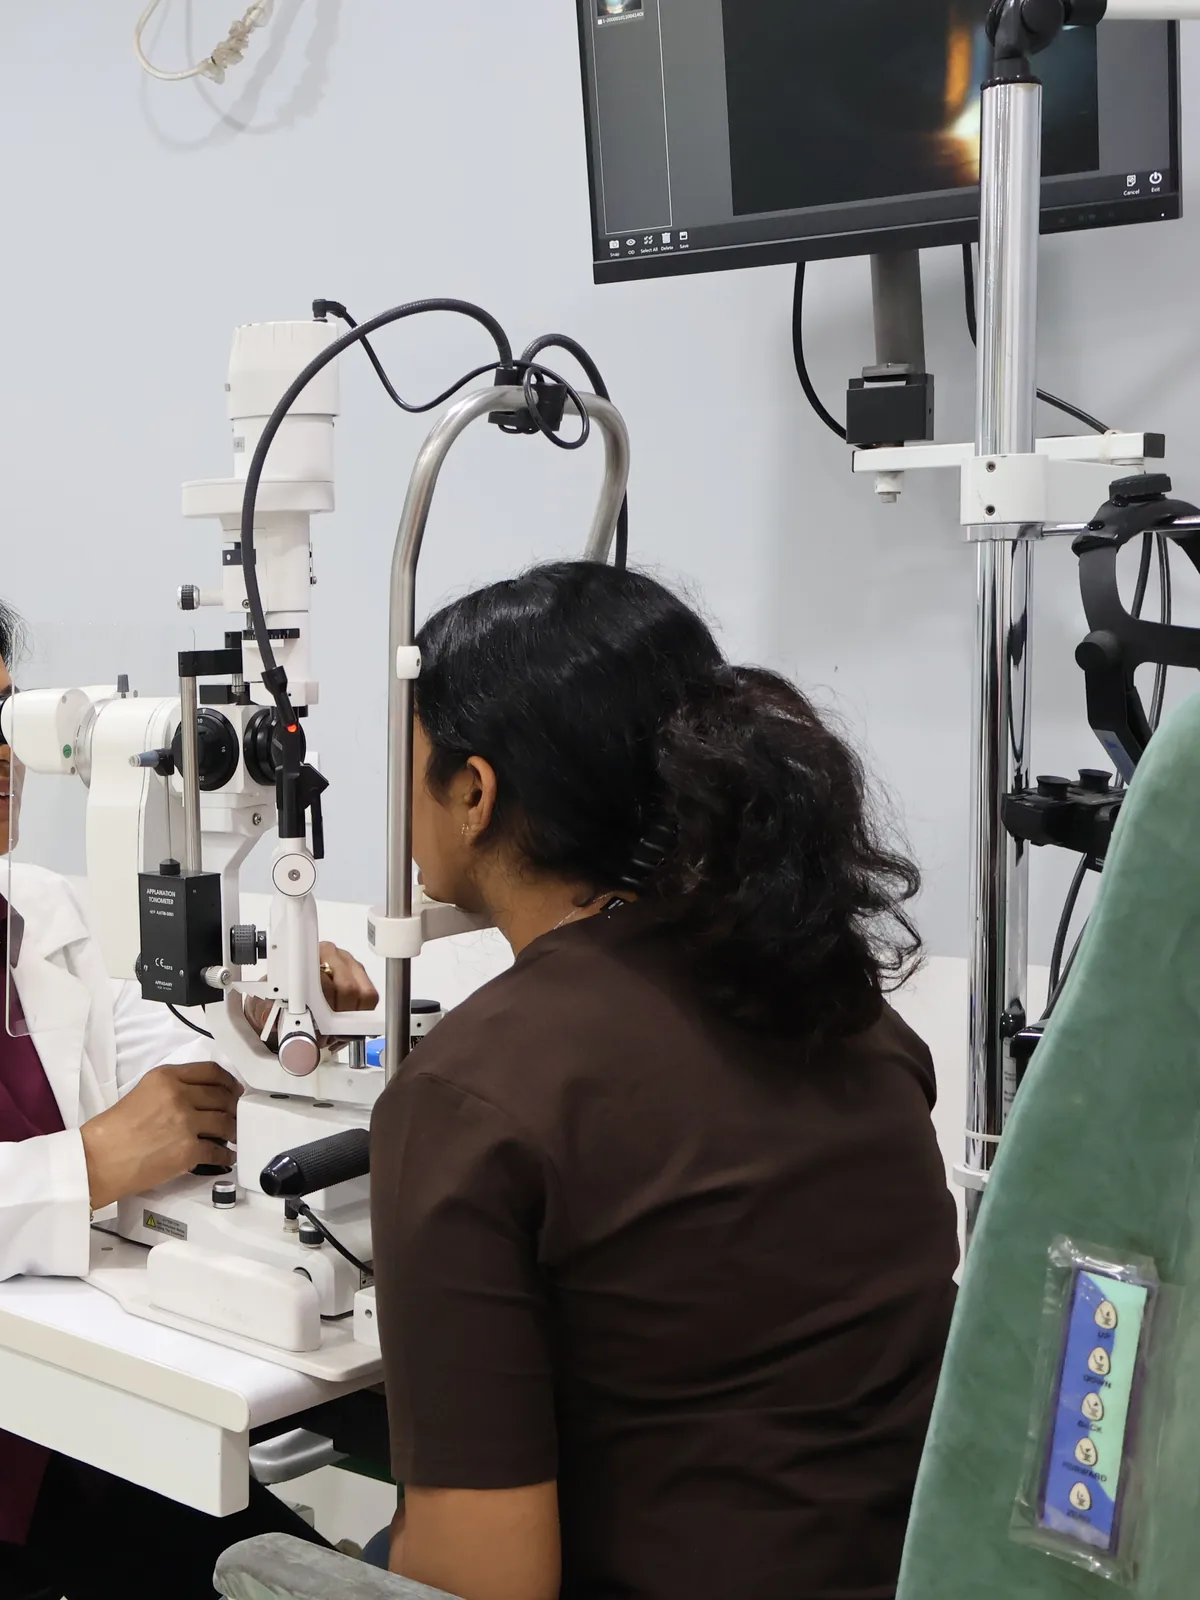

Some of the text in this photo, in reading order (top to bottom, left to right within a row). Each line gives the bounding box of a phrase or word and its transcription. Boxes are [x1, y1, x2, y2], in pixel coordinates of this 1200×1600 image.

[1123, 188, 1140, 196] Cancel
[146, 888, 176, 898] APPLANATION
[148, 896, 174, 905] TONOMETER
[1097, 1331, 1112, 1340] UP
[1083, 1374, 1112, 1390] DOWN
[1077, 1419, 1103, 1434] BACK
[1062, 1461, 1108, 1483] FORWARD
